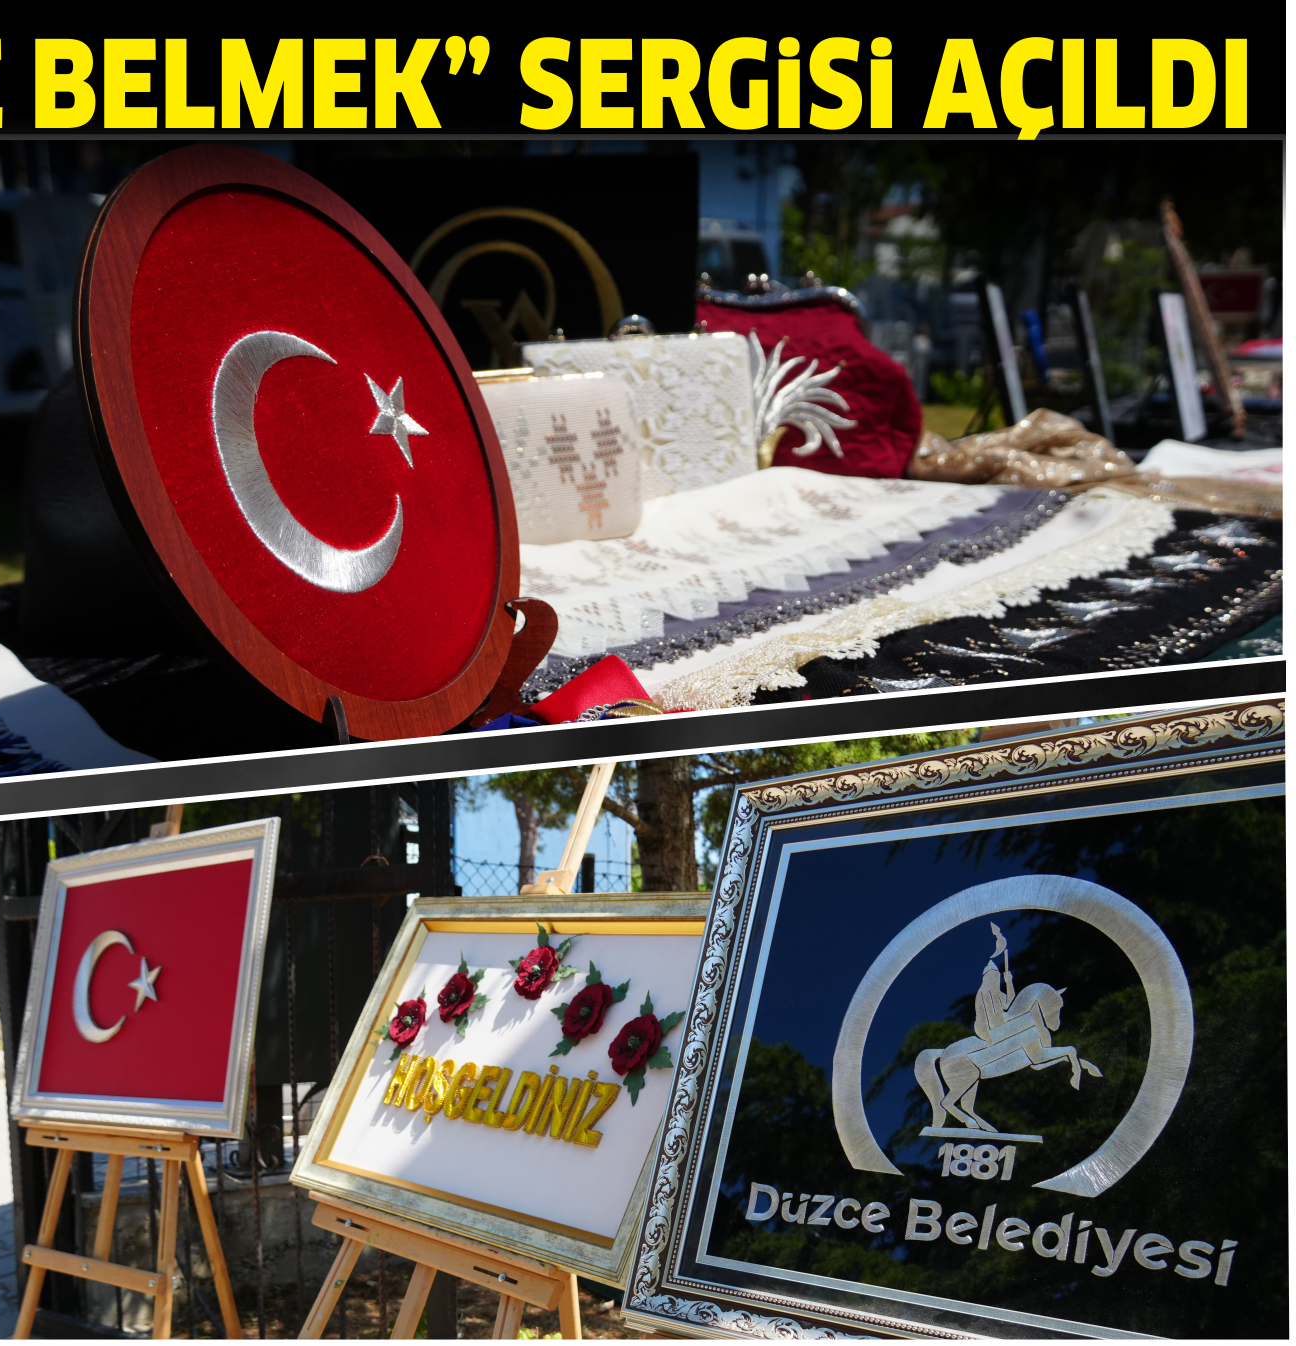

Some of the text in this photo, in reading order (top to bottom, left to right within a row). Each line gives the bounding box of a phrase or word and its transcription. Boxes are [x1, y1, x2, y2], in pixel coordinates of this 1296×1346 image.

[382, 1052, 621, 1148] HOŞGELDİNİZ
[937, 1142, 1017, 1181] 1881
[745, 1181, 1238, 1287] Düzce Belediyesi
